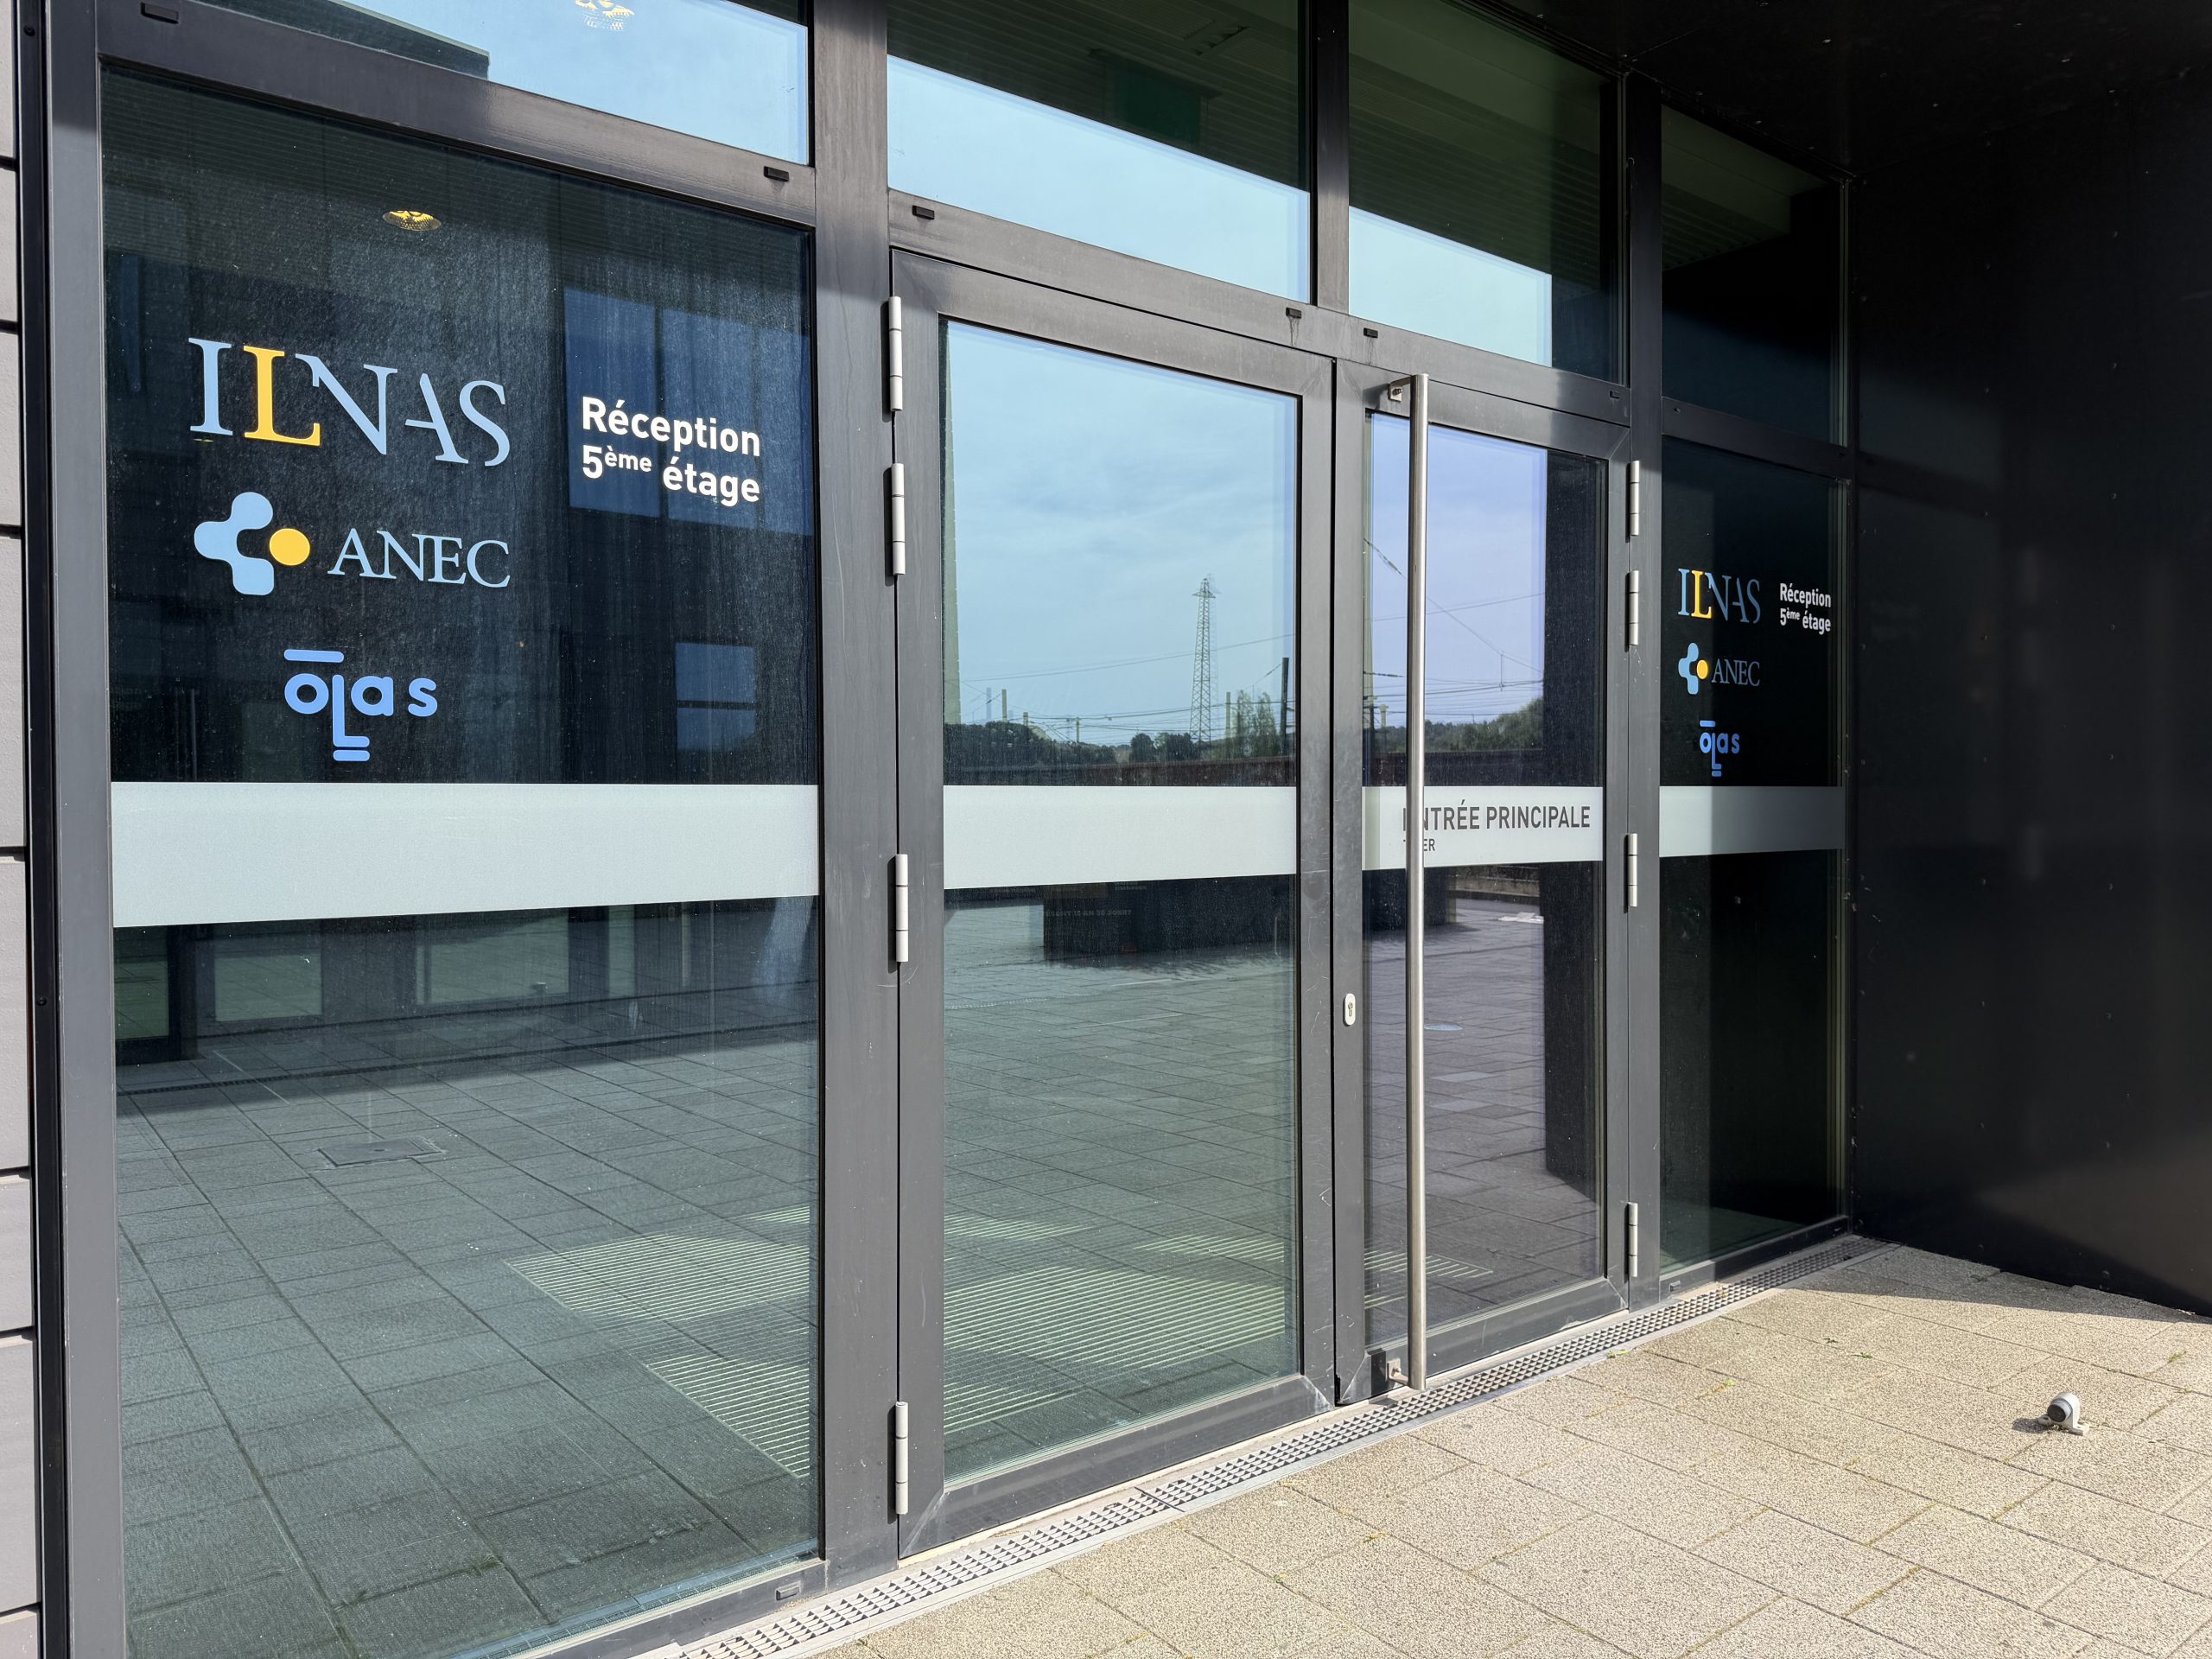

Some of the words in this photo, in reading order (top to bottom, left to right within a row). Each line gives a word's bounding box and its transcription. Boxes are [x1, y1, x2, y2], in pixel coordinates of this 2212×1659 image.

[188, 338, 510, 467] ILNAS
[582, 396, 760, 458] Réception
[582, 444, 652, 480] 5ème
[663, 463, 760, 507] étage
[327, 528, 511, 588] ANEC
[1678, 568, 1761, 624] ILNAS
[1780, 582, 1832, 608] Réception
[1780, 607, 1801, 626] 5ème
[1802, 611, 1832, 635] étage
[1711, 658, 1761, 687] ANEC
[1486, 805, 1591, 830] PRINCIPALE
